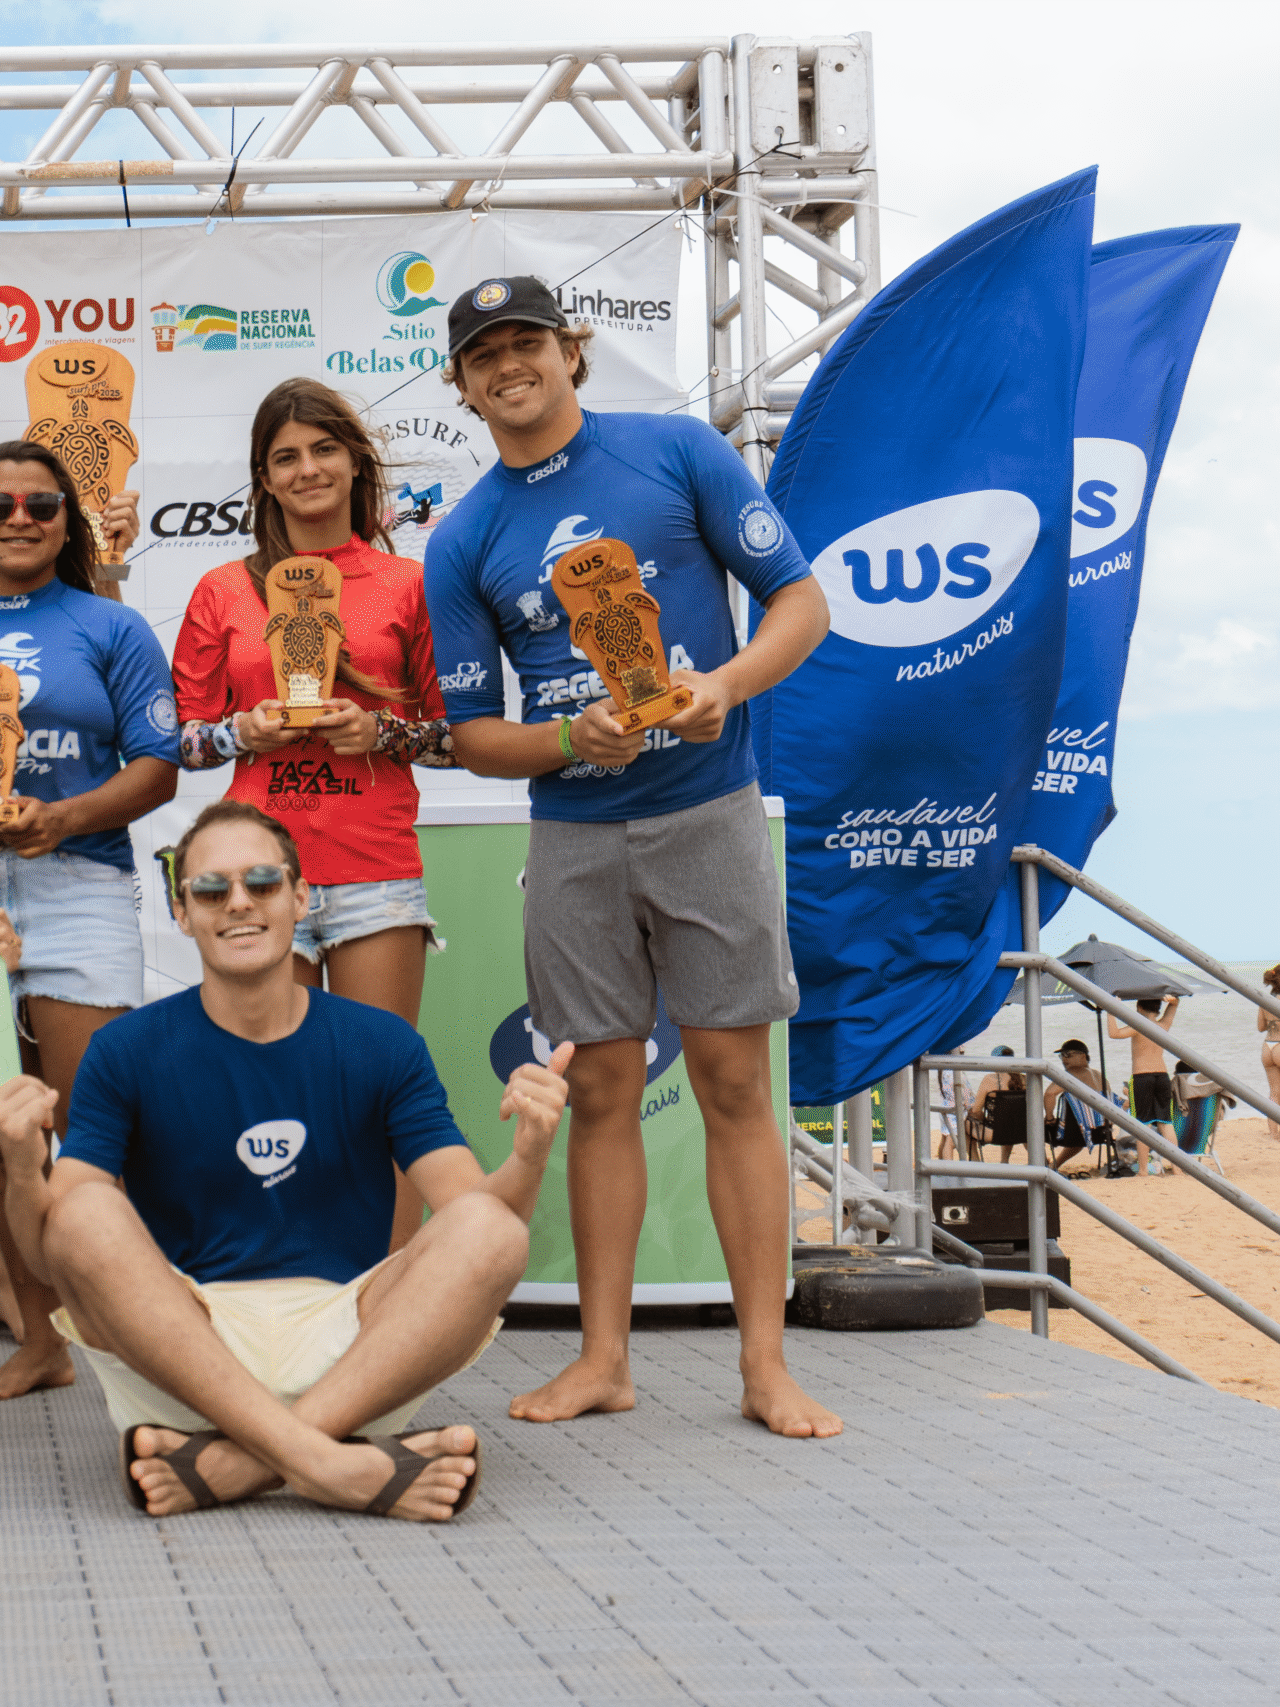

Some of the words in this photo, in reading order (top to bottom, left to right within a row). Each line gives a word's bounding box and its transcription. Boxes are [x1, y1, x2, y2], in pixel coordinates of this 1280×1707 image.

[44, 298, 135, 333] YOU
[240, 308, 311, 325] RESERVA
[556, 286, 672, 321] Linhares
[240, 324, 316, 340] NACIONAL
[382, 321, 436, 341] Sítio
[326, 347, 405, 375] Belas
[379, 417, 469, 450] ESURF
[895, 611, 1014, 682] naturais
[1047, 750, 1108, 776] VIDA
[1031, 771, 1079, 795] SER
[836, 791, 998, 830] saudável
[824, 828, 903, 849] COMO
[909, 830, 933, 848] A
[941, 823, 998, 848] VIDA
[849, 847, 919, 869] DEVE
[926, 847, 977, 868] SER
